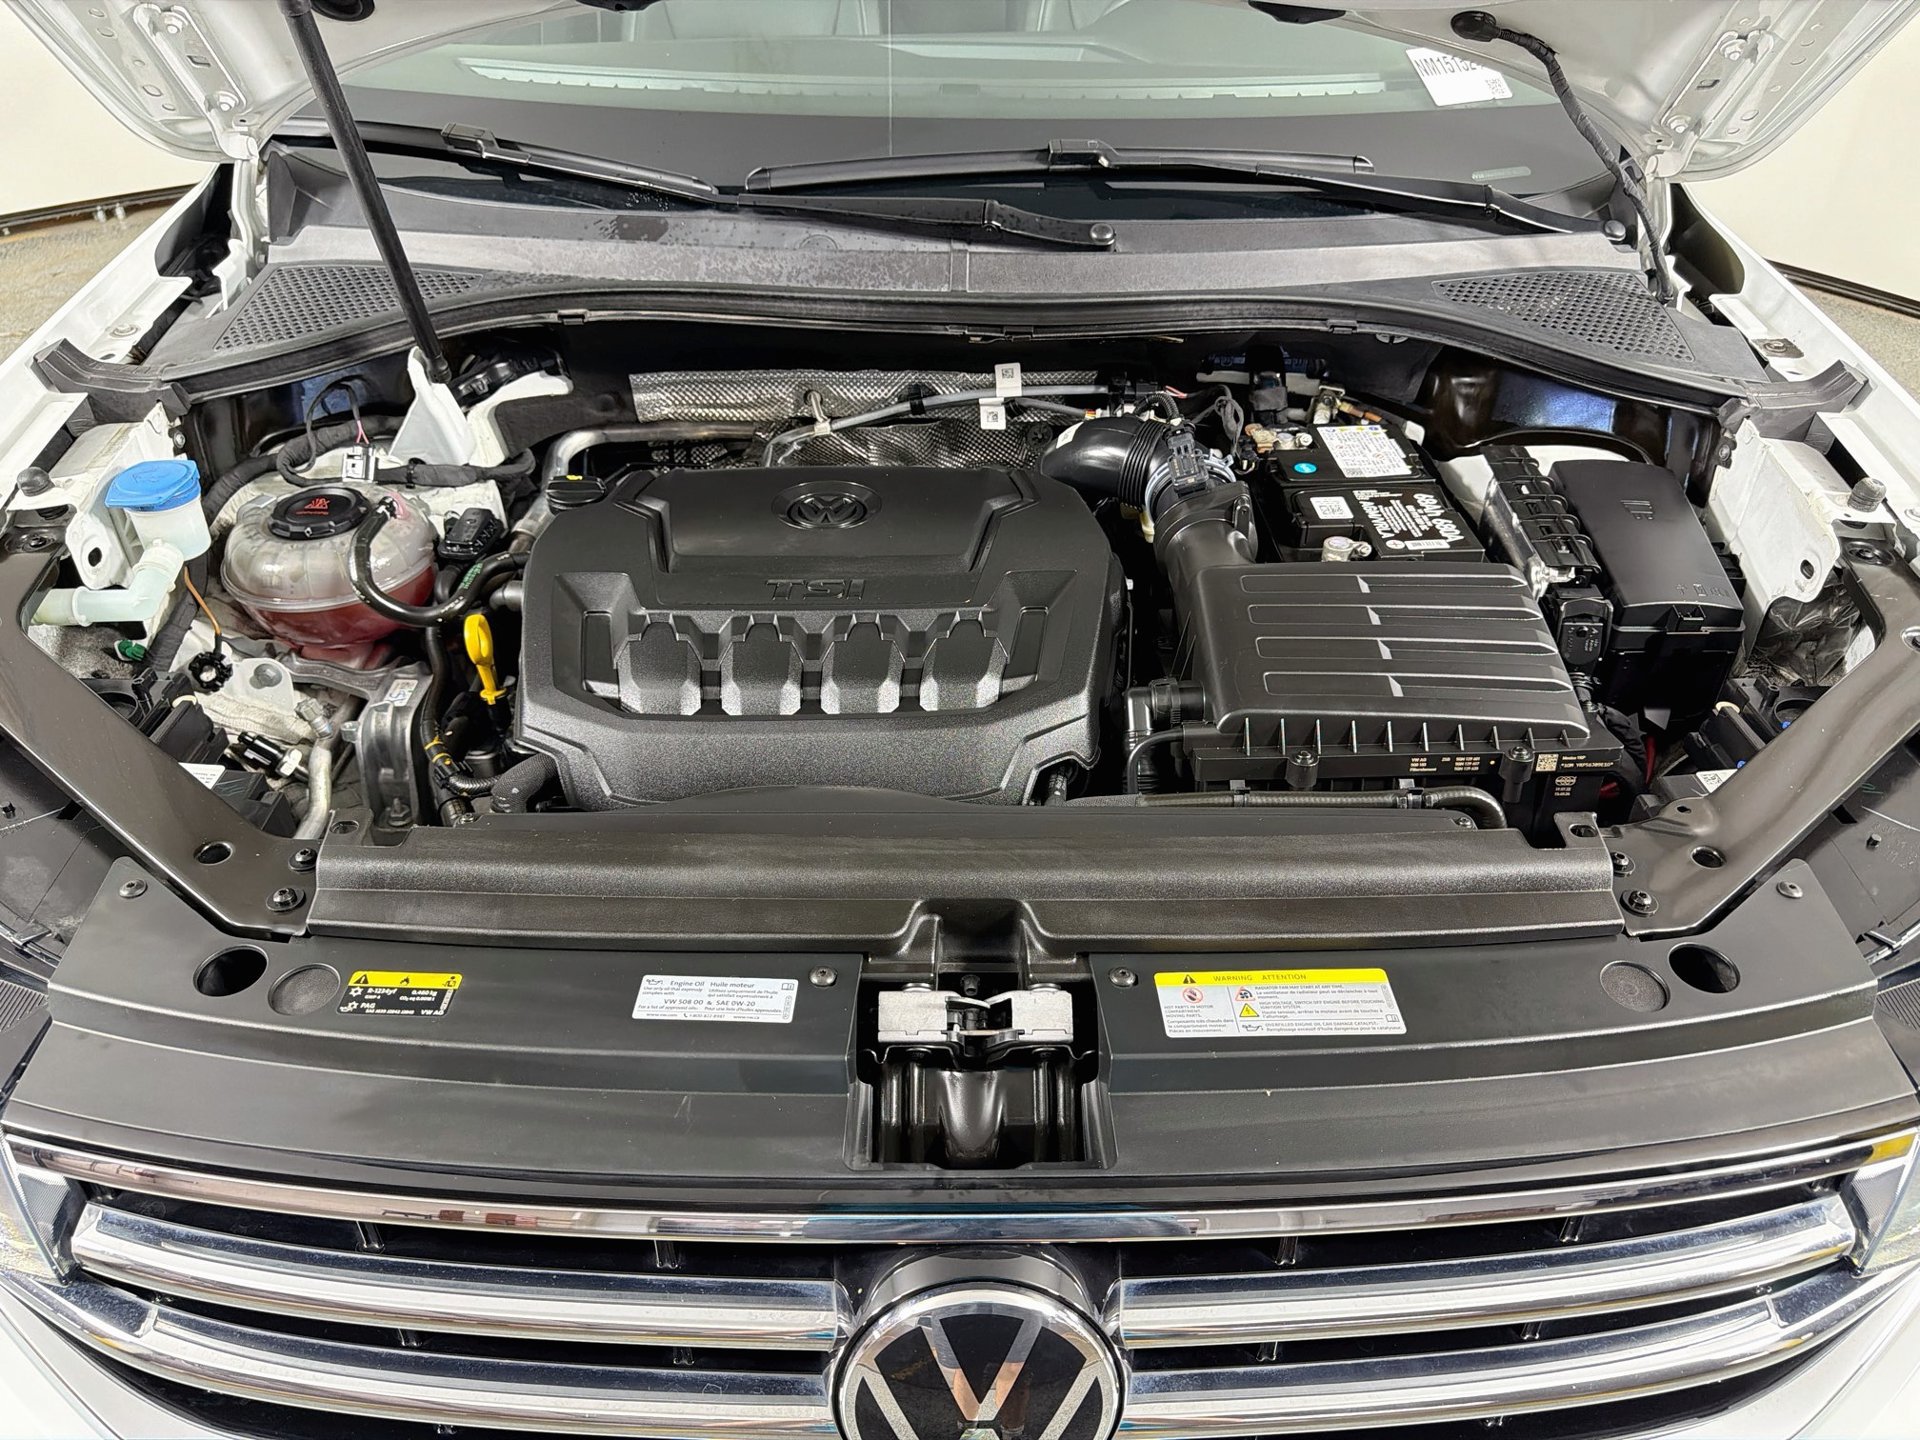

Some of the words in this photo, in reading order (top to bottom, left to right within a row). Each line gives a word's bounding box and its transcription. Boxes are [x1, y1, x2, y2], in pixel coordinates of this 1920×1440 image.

[1414, 56, 1485, 77] NM1515
[1414, 493, 1445, 517] 68Ah
[1432, 518, 1464, 543] 680A
[766, 579, 865, 600] TSI
